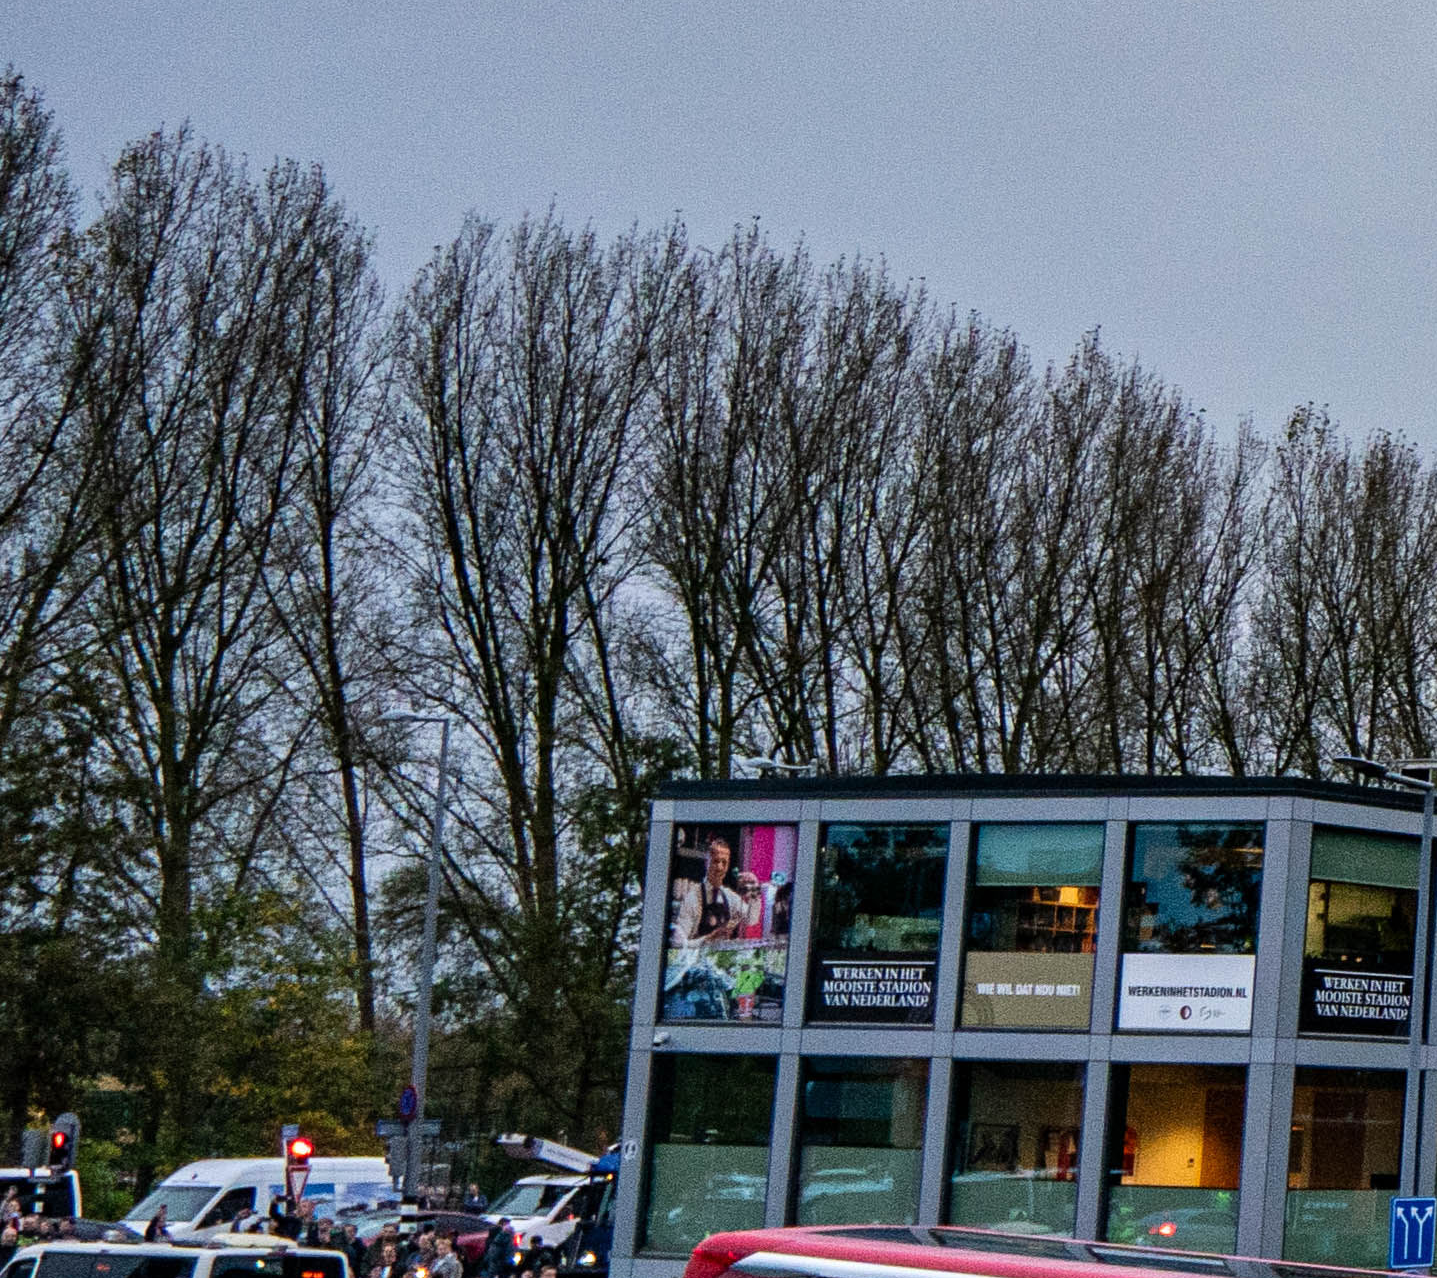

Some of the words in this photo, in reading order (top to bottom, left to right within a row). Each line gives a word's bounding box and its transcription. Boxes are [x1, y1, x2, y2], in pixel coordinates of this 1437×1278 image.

[832, 968, 883, 980] WERKEN
[886, 968, 898, 979] IN
[901, 968, 925, 980] HET
[823, 981, 877, 994] MOOISTE
[879, 982, 932, 994] STADION
[1323, 976, 1368, 991] WERKEN
[1371, 979, 1384, 991] IN
[1386, 981, 1405, 993] HET
[1128, 985, 1247, 999] WERKENINHETSTADION.NL
[1314, 989, 1363, 1003] MOOISTE
[1365, 992, 1411, 1006] STADION
[824, 994, 850, 1006] VAN
[851, 994, 929, 1007] NEDERLAND?
[1316, 1003, 1340, 1016] VAN
[1340, 1005, 1408, 1021] NEDERLAND?
